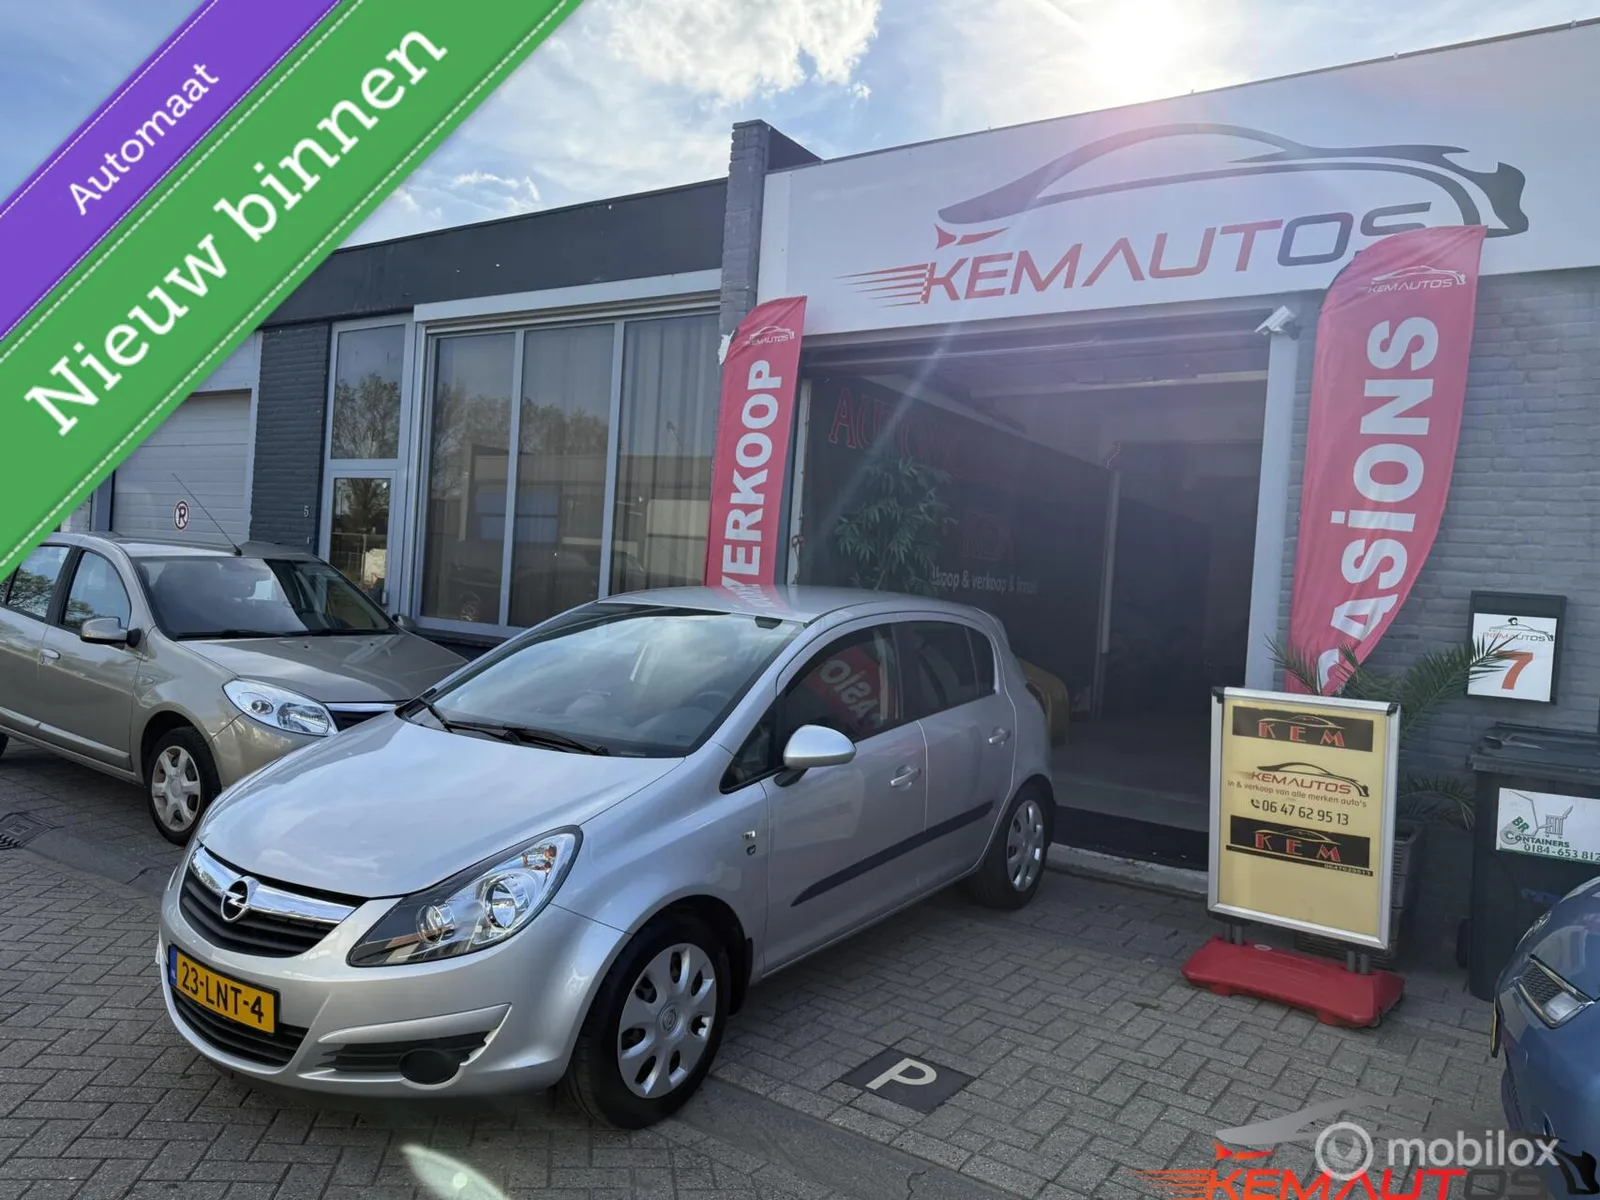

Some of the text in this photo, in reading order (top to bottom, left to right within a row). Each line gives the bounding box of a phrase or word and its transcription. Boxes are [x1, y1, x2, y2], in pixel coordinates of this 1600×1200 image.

[921, 201, 1431, 305] KEMAUTOS
[1368, 278, 1453, 293] KEMAUTOS
[1496, 649, 1534, 690] 7
[1244, 783, 1274, 794] verkoop
[1276, 788, 1290, 796] van
[1291, 790, 1306, 799] alle
[1308, 793, 1339, 804] merken
[1251, 771, 1351, 795] KEMAUTOS
[1262, 799, 1349, 826] 06 47 62 95 13
[181, 961, 265, 1024] 23-LNT-4
